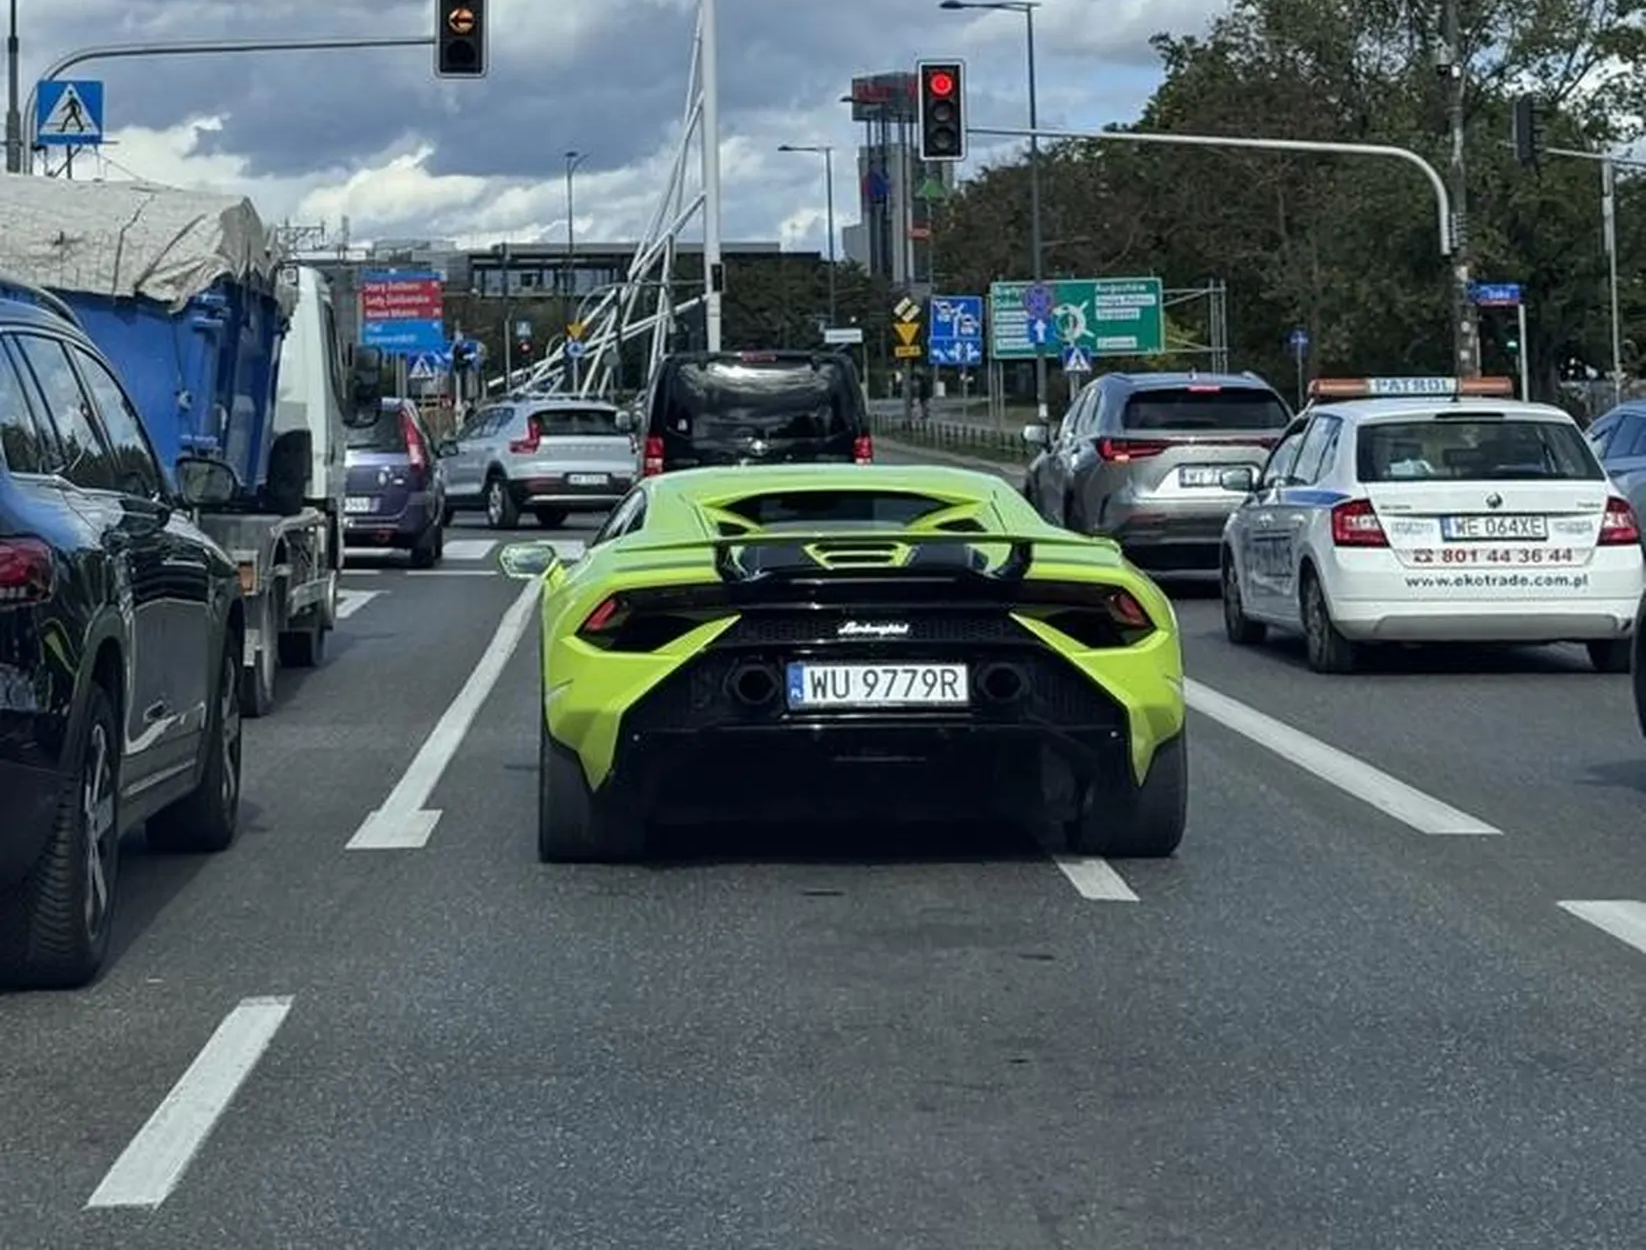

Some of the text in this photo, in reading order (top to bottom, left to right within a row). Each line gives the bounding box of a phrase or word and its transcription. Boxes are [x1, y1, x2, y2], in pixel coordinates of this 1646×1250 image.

[1374, 378, 1452, 392] PATROL
[1455, 518, 1479, 536] WE
[1485, 517, 1542, 536] 064XE
[1441, 549, 1574, 563] 801 44 36 44
[1405, 574, 1589, 588] www.ekotrade.com.pl
[810, 668, 959, 699] WU 9779R
